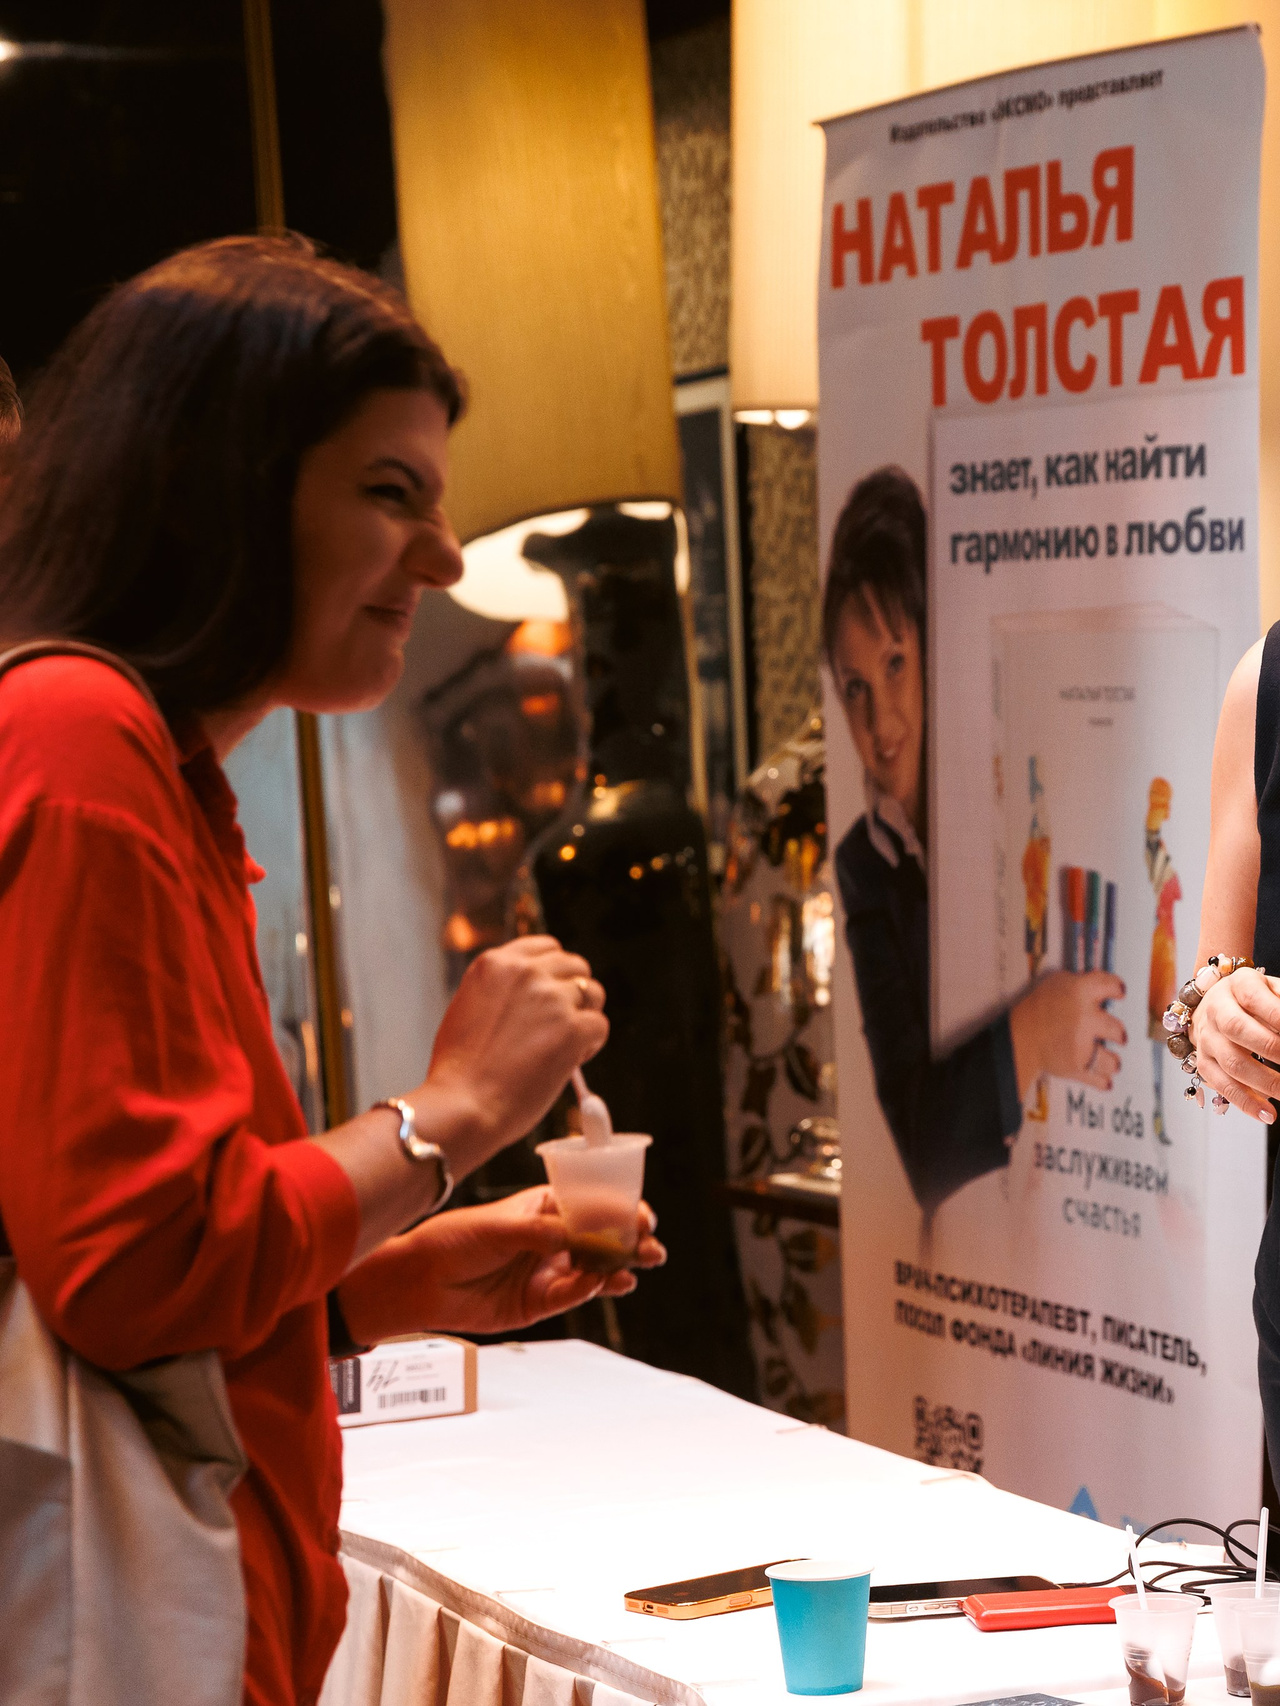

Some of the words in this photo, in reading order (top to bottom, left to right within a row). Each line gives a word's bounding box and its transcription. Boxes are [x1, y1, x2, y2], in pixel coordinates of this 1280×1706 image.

[831, 145, 1135, 289] НАТАЛЬЯ
[920, 275, 1246, 407] ТОЛСТАЯ
[949, 457, 1037, 498] знает,
[1044, 451, 1100, 487] как
[1104, 432, 1208, 483] найти
[949, 525, 1100, 574] гармонию
[1105, 523, 1119, 557] в
[1124, 506, 1246, 556] любви
[1066, 1088, 1105, 1130] Мы
[1112, 1096, 1144, 1138] оба
[1062, 1197, 1142, 1239] счастья
[952, 1319, 1017, 1358] ФОНДА
[1102, 1315, 1208, 1377] ПИСАТЕЛЬ,
